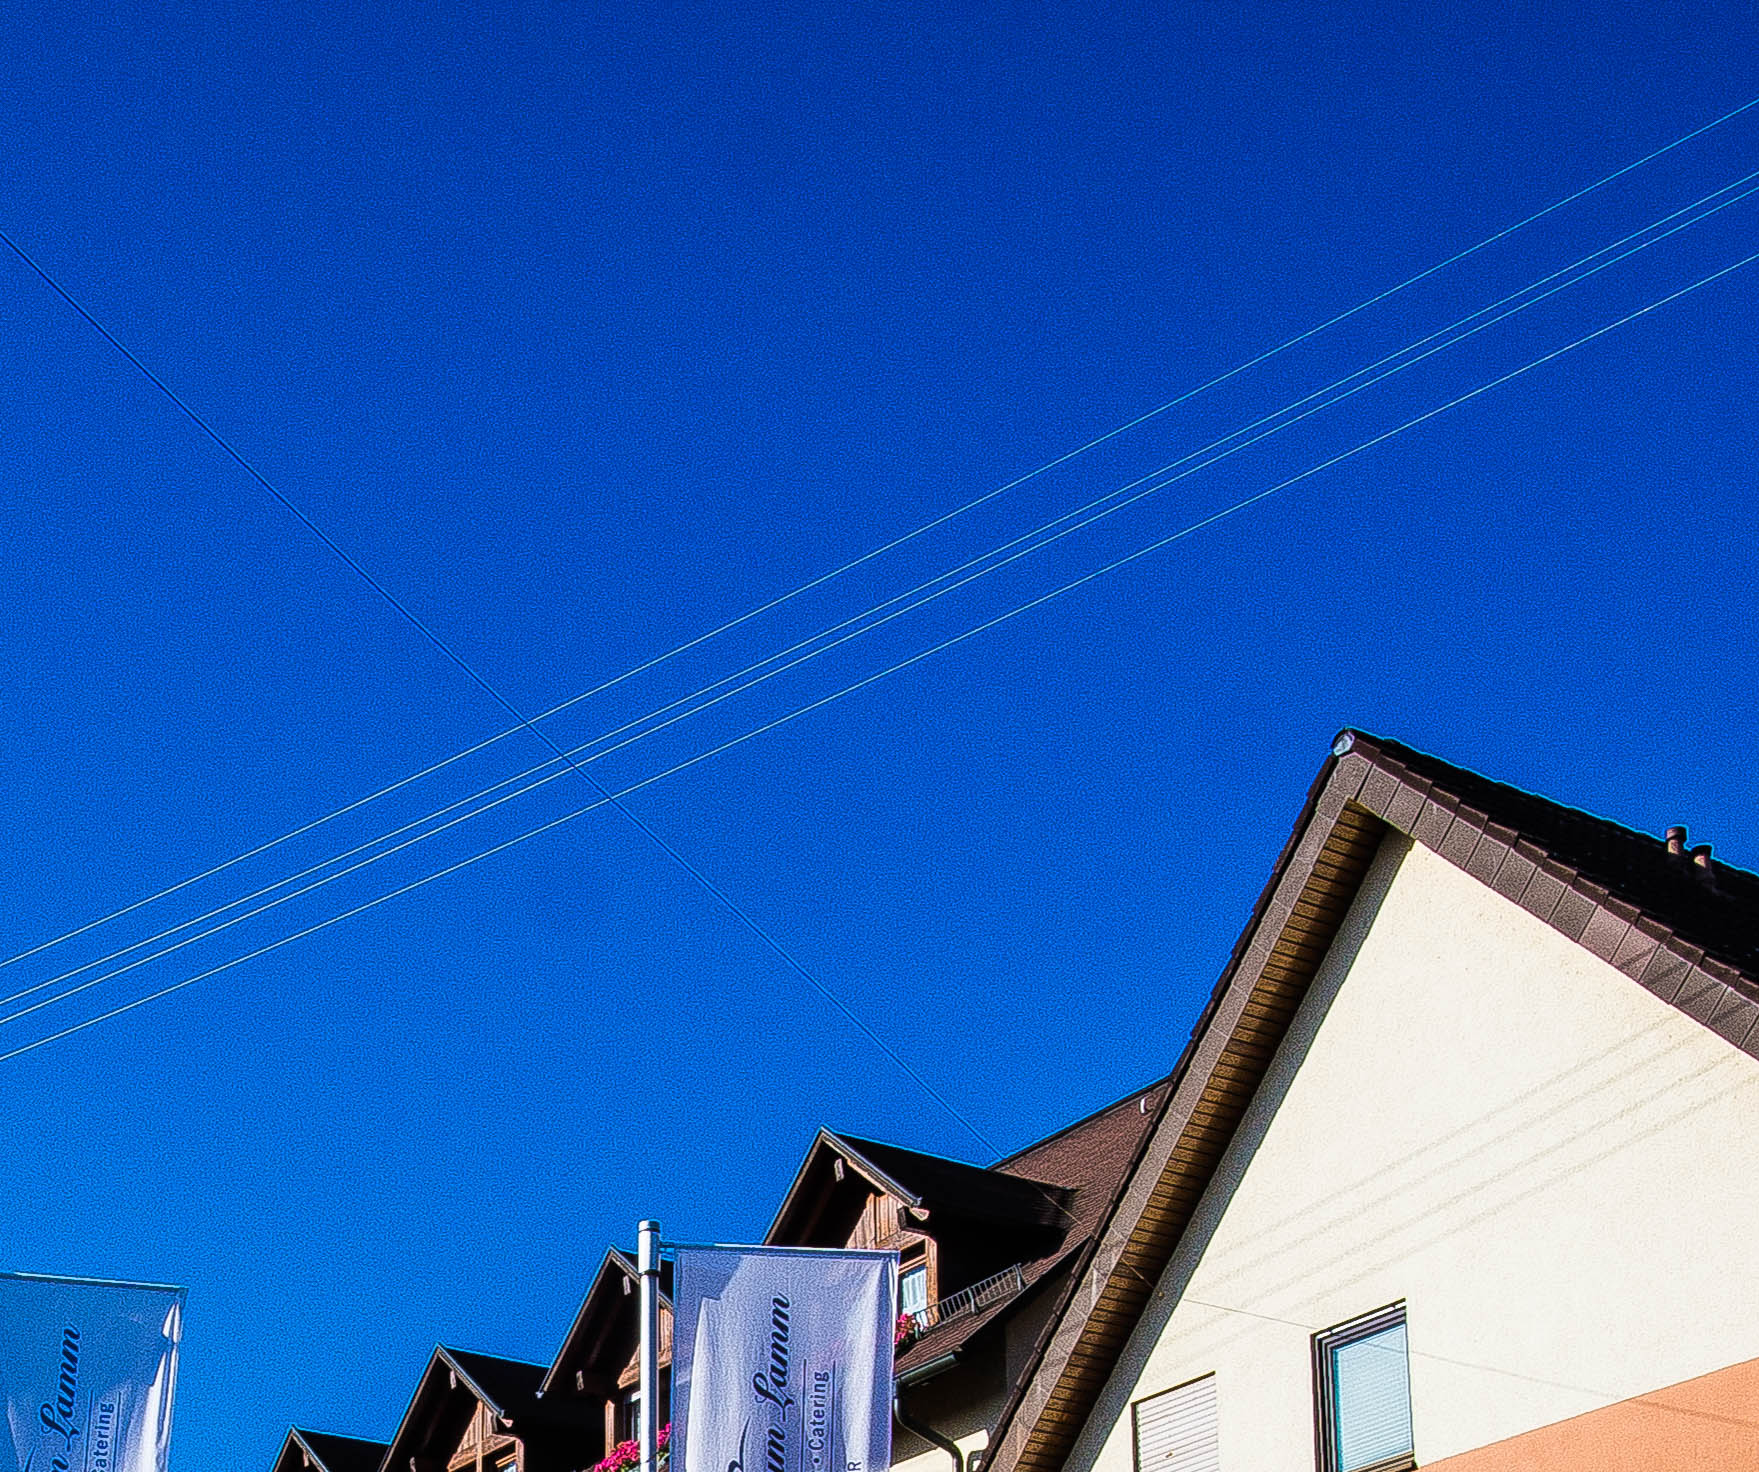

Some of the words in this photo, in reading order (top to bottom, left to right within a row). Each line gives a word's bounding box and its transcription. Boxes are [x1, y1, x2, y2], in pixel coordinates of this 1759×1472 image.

[40, 1322, 81, 1451] Lamm
[752, 1291, 795, 1422] Lamm
[808, 1371, 830, 1451] Catering
